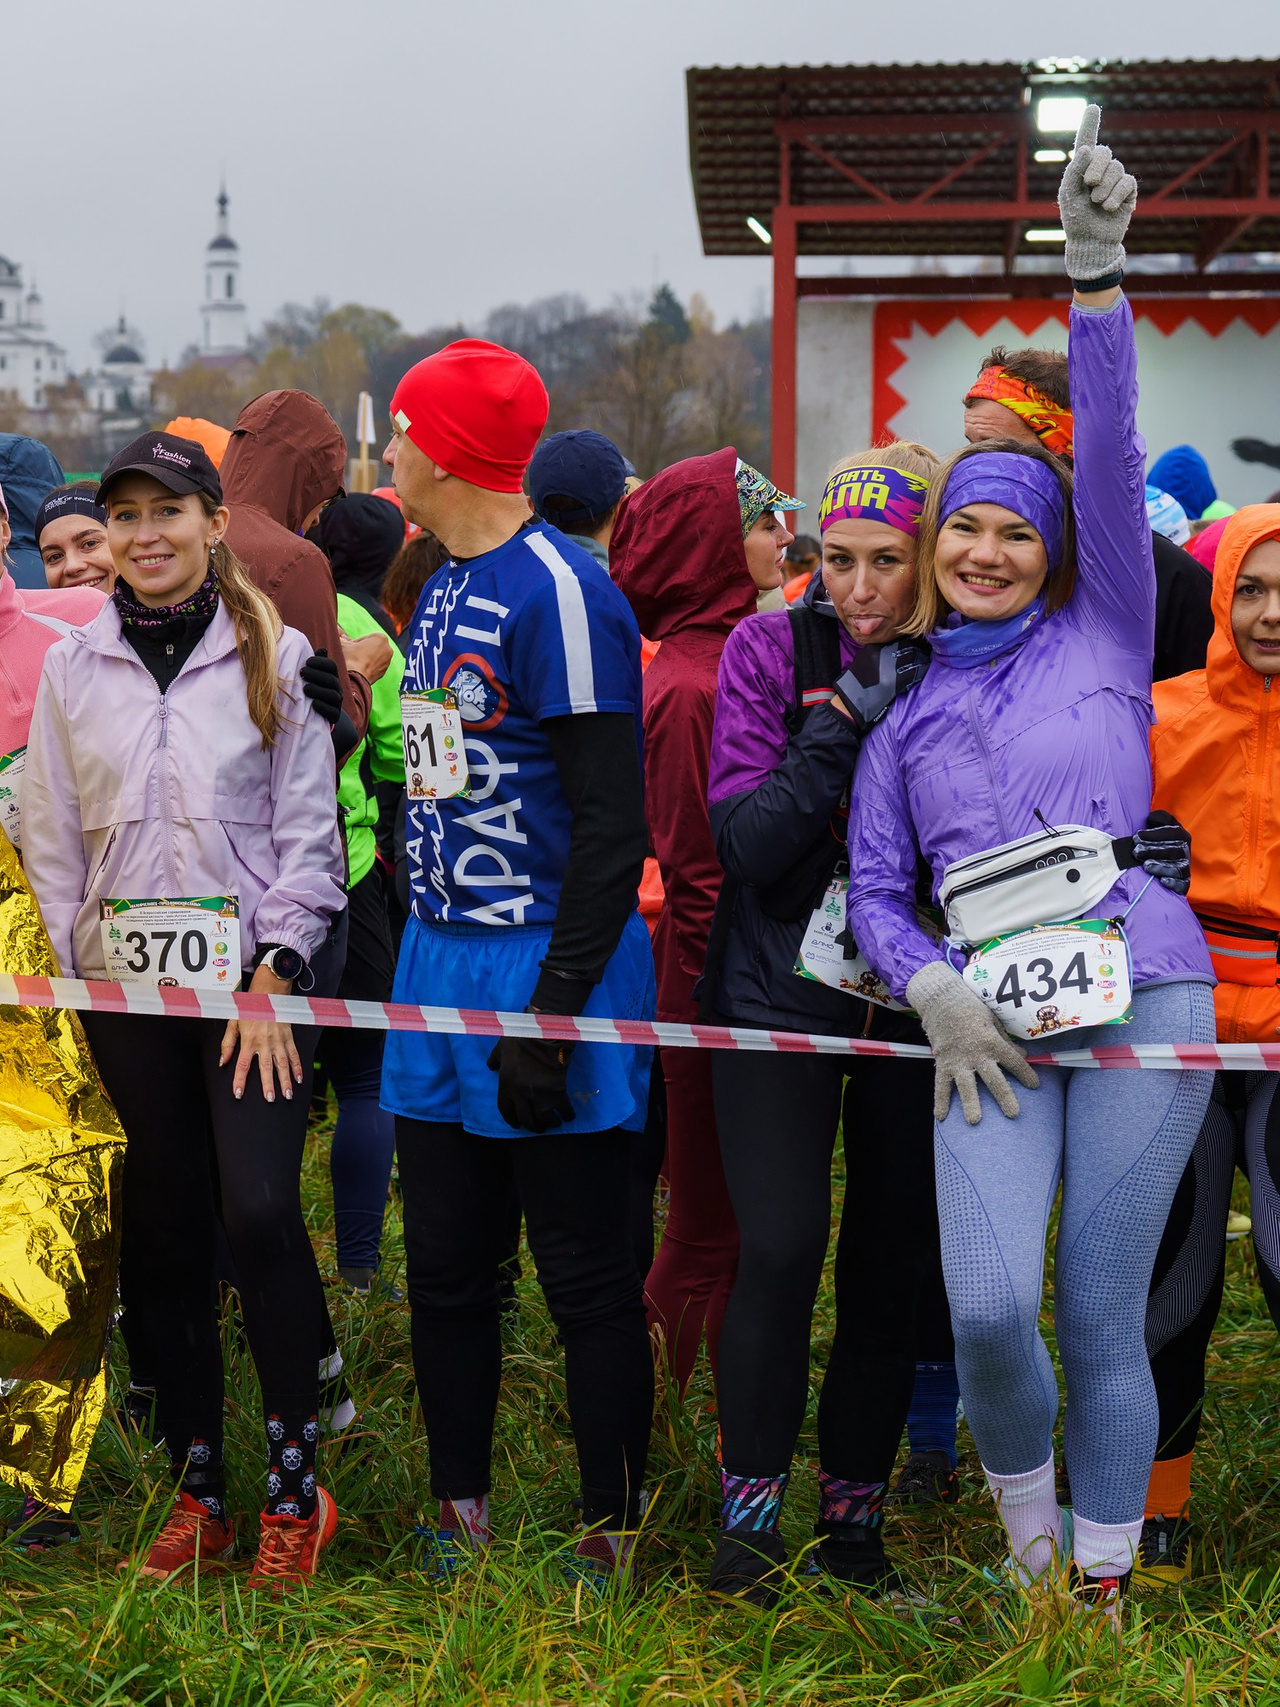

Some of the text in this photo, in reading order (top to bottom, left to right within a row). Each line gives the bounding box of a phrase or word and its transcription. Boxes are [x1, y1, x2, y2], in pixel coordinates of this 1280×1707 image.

[158, 449, 192, 465] Fashion
[819, 482, 890, 524] ИЛА
[402, 722, 438, 769] 61
[125, 929, 208, 973] 370
[995, 951, 1094, 1009] 434
